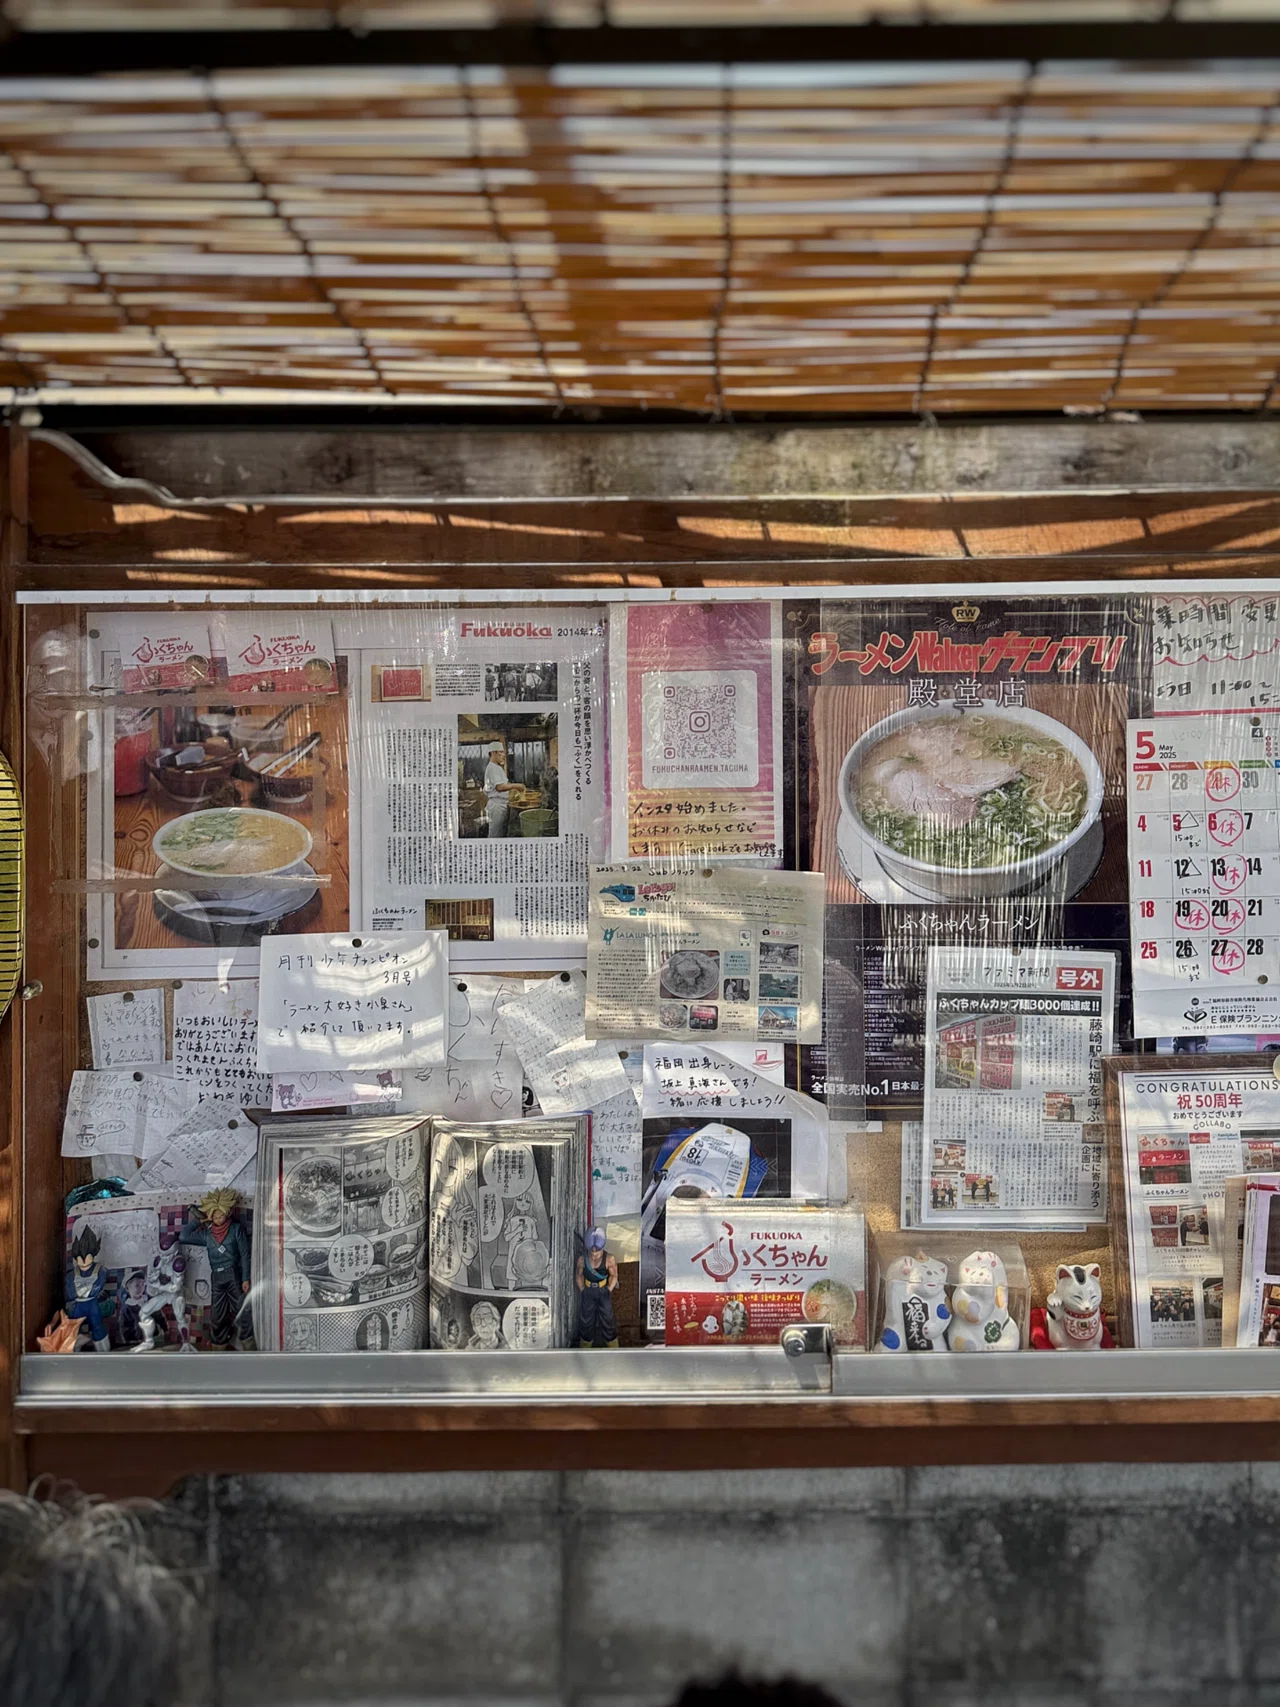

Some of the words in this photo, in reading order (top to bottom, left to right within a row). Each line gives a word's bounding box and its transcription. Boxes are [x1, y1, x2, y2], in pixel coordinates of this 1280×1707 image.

[956, 609, 976, 617] RW
[460, 622, 553, 638] Fukuoka
[1153, 632, 1239, 655] お知らせ
[158, 654, 184, 662] ラーメン
[272, 657, 303, 666] ラーメン
[1135, 730, 1156, 760] 5
[1159, 744, 1174, 754] May
[1159, 751, 1177, 759] 2025
[1136, 774, 1153, 791] 27
[1171, 773, 1189, 790] 28
[1242, 771, 1259, 789] 30
[1137, 815, 1147, 832] 4
[1172, 814, 1182, 832] 5
[1208, 813, 1217, 831] 6
[1217, 819, 1237, 836] 休
[1244, 812, 1253, 830] 7
[1138, 860, 1153, 878] 11
[1174, 859, 1190, 877] 12
[1210, 858, 1226, 876] 13
[1224, 865, 1240, 885] 休
[1247, 857, 1263, 876] 14
[1139, 901, 1155, 918] 18
[1175, 900, 1191, 917] 19
[1211, 899, 1229, 917] 20
[1248, 899, 1263, 916] 21
[900, 912, 1040, 932] ふくちゃんラーメン
[1184, 909, 1205, 926] 休
[1224, 910, 1242, 925] 休
[1140, 941, 1158, 959] 25
[1175, 940, 1193, 959] 26
[1211, 939, 1229, 956] 27
[1246, 939, 1264, 956] 28
[1219, 950, 1240, 967] 休
[383, 970, 412, 986] 3月号
[984, 966, 1050, 978] ファミマ新聞
[1059, 969, 1100, 988] 号外
[1211, 1014, 1280, 1024] E保険プランニン
[1087, 1018, 1103, 1123] 藤崎駅に福を呼ぶ
[811, 1079, 890, 1096] 全国実売No.1
[1136, 1079, 1280, 1094] CONGRATULATIONS
[1177, 1094, 1193, 1110] 祝
[1195, 1092, 1244, 1109] 50周年
[1173, 1110, 1244, 1120] おめでとうございます
[1193, 1119, 1232, 1131] COLLABO
[1081, 1144, 1091, 1172] 企画に
[1145, 1188, 1190, 1196] ふくちゃんラーメン
[750, 1231, 803, 1241] FUKUOKA
[750, 1272, 804, 1286] ラーメン
